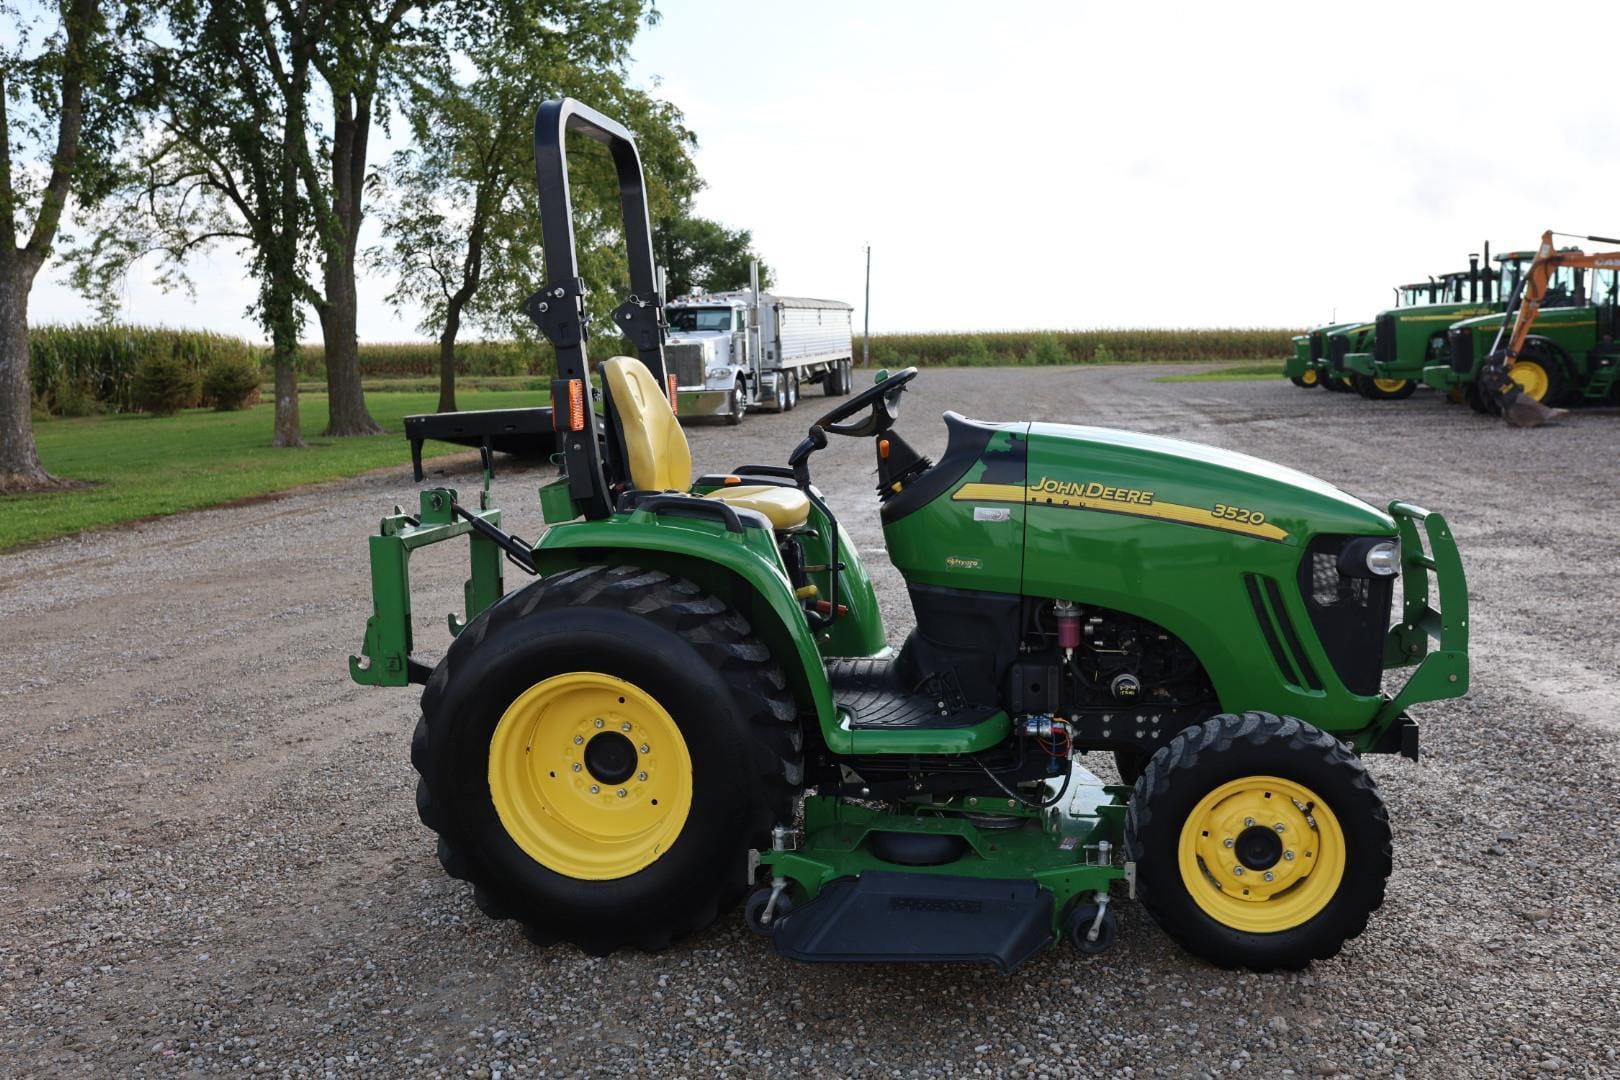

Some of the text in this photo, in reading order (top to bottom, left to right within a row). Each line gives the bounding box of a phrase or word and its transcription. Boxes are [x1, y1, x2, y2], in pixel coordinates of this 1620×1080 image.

[1030, 476, 1154, 505] JOHN DEERE
[1211, 502, 1266, 525] 3520
